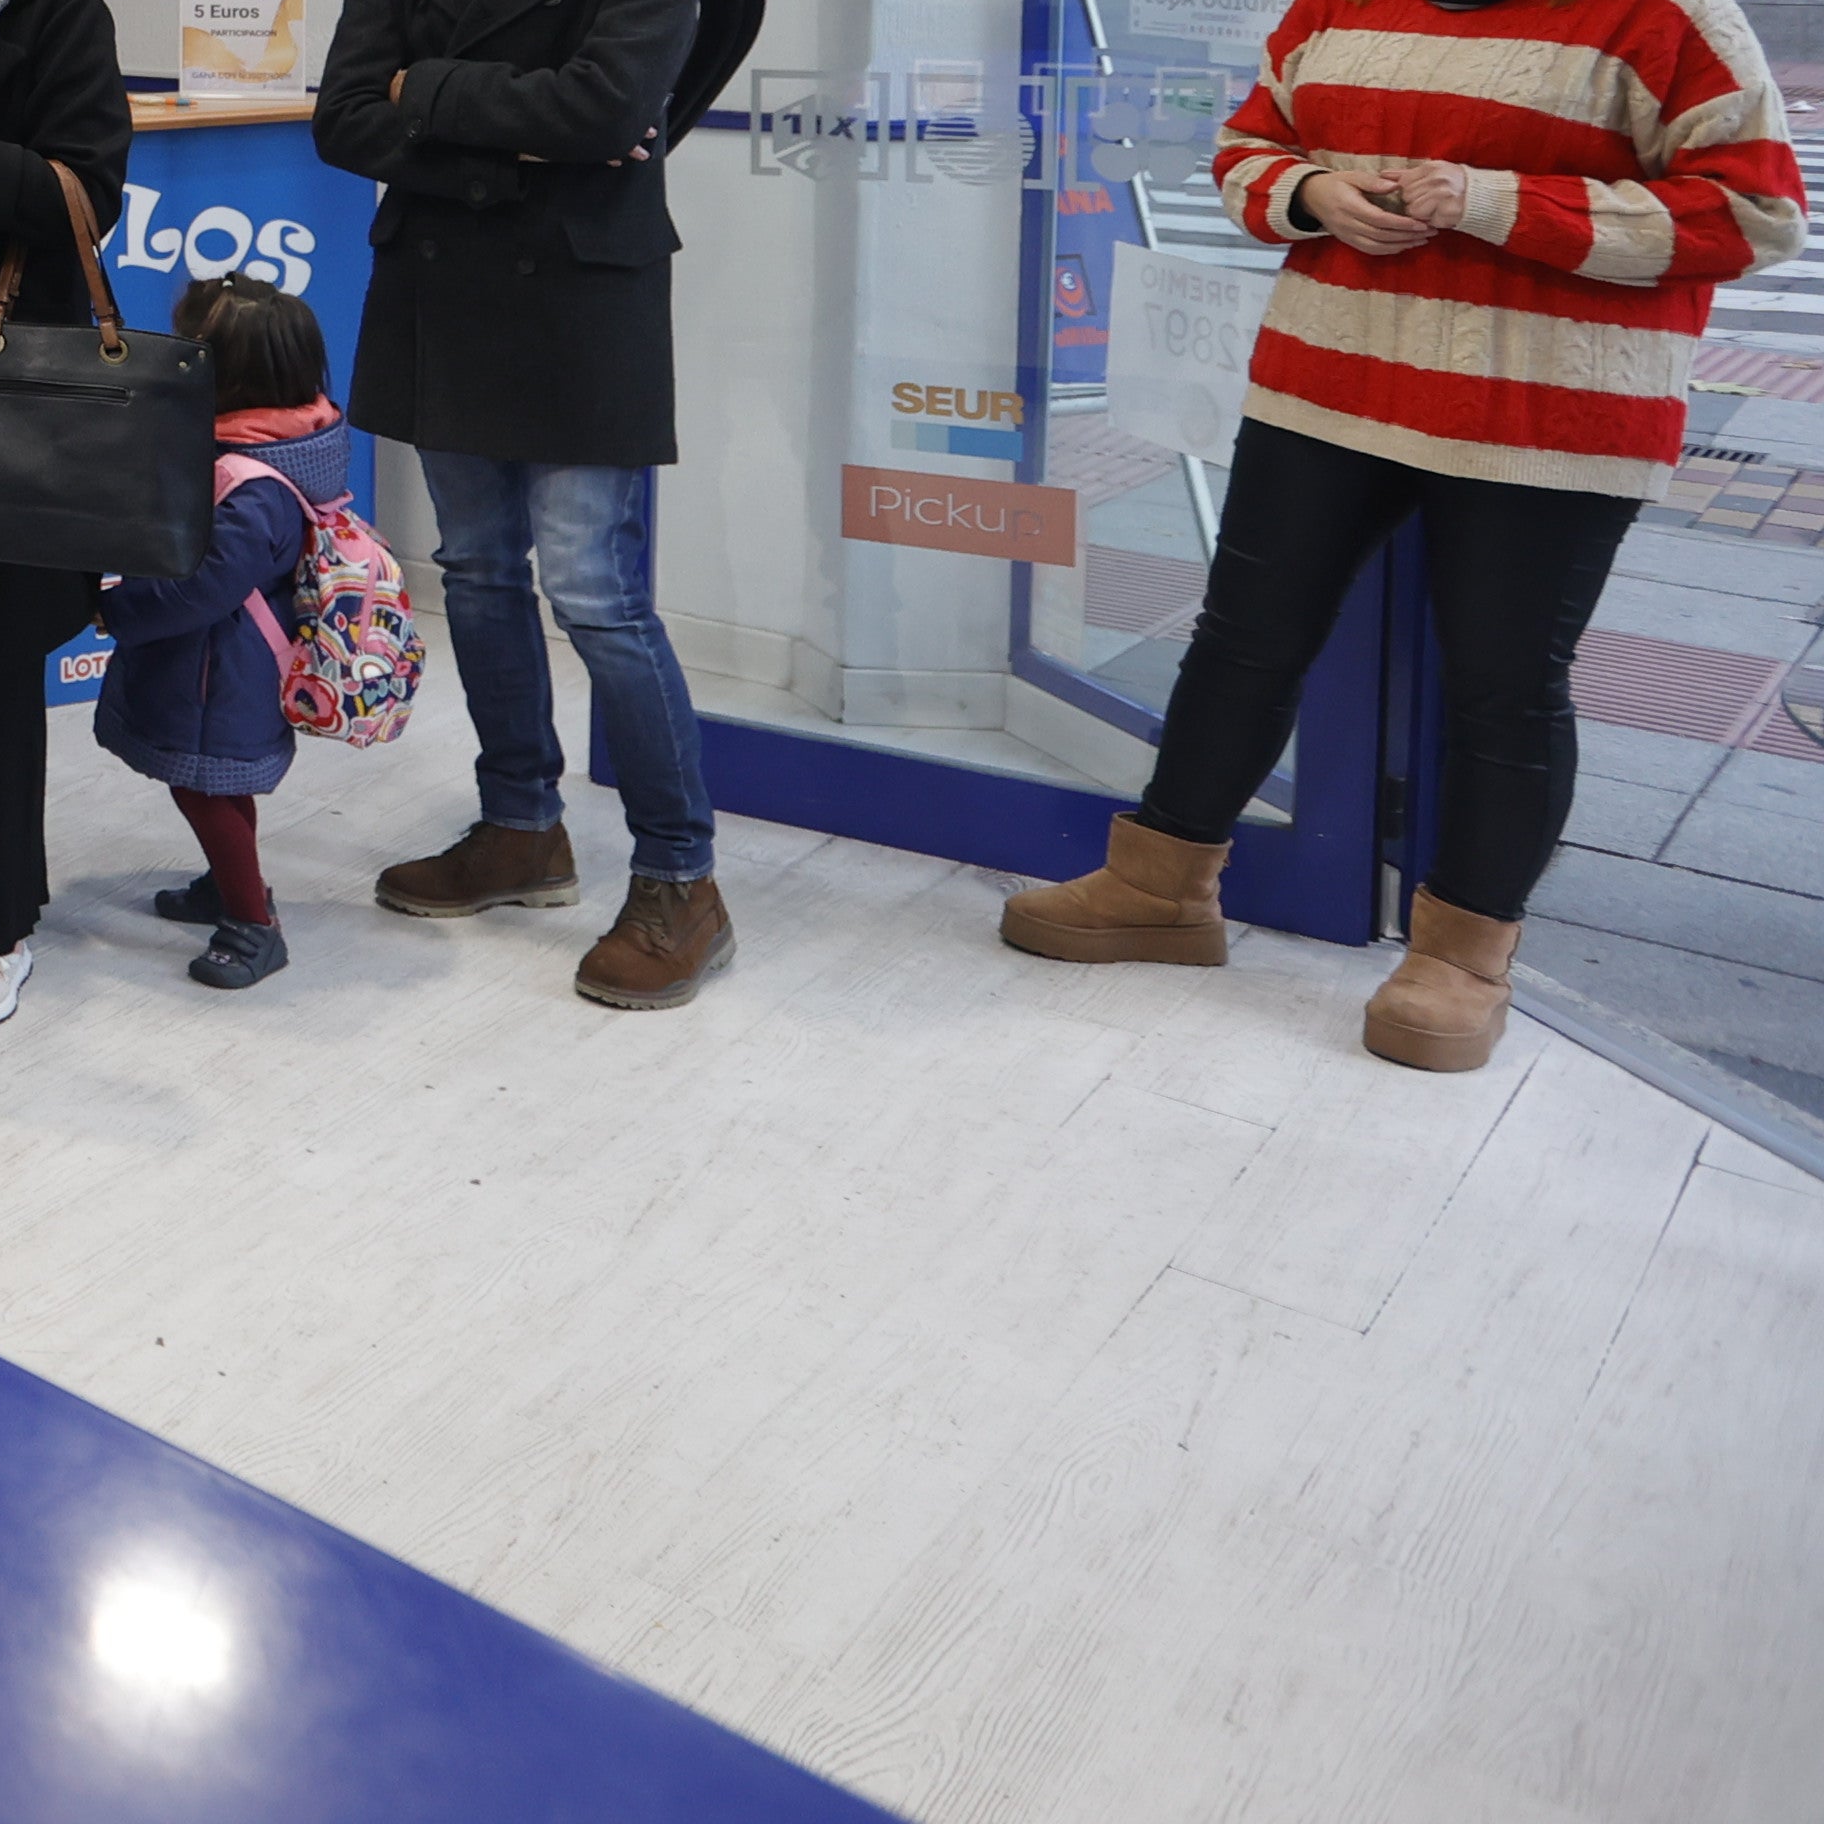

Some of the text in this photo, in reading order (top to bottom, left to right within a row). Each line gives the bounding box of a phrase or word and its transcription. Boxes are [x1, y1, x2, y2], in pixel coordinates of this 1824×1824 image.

[194, 4, 260, 19] 5 Euros
[210, 29, 278, 37] PARTICIPACION
[100, 181, 317, 297] LOS
[891, 381, 1025, 425] SEUR
[869, 484, 1045, 543] Pickup
[61, 653, 111, 682] LOT
